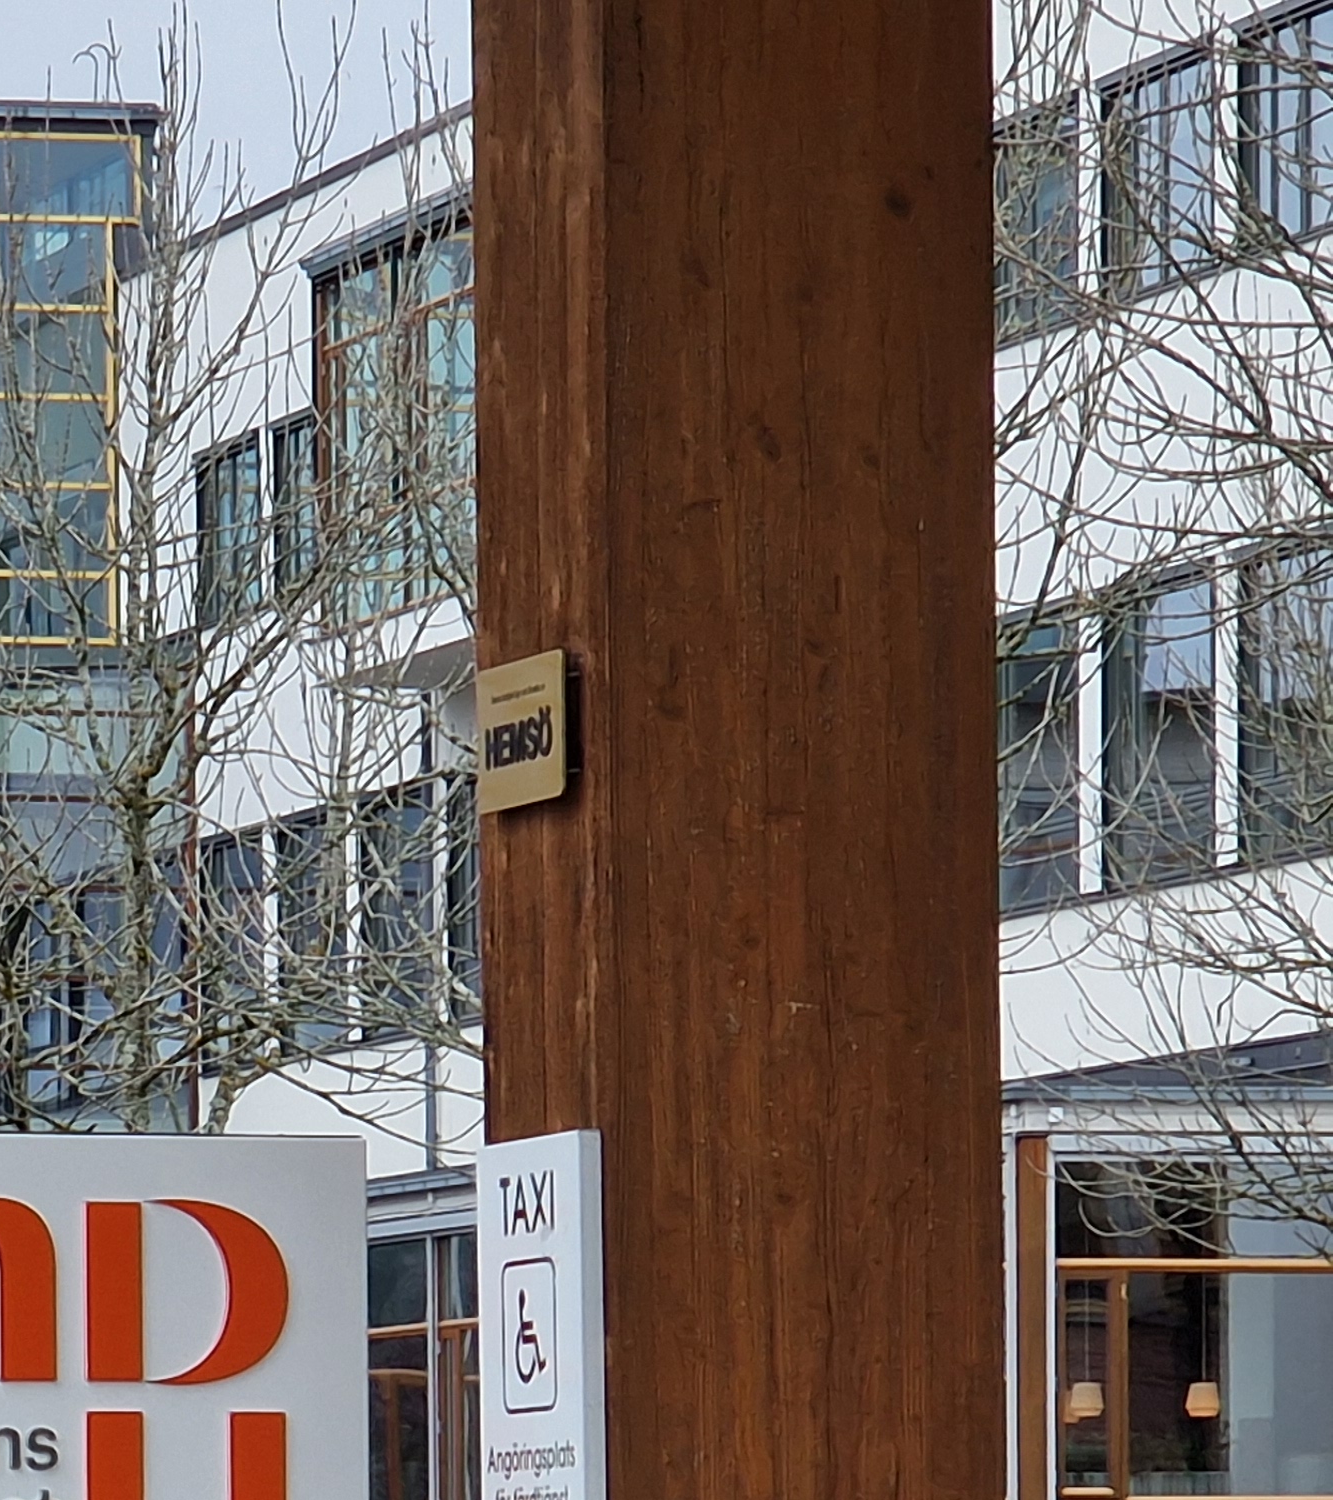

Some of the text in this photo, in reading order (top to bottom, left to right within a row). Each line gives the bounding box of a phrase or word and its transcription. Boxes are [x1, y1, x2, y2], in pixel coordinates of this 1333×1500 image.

[485, 704, 553, 771] HEMSÖ
[499, 1170, 555, 1236] TAXI
[487, 1440, 576, 1480] Angöringsplats
